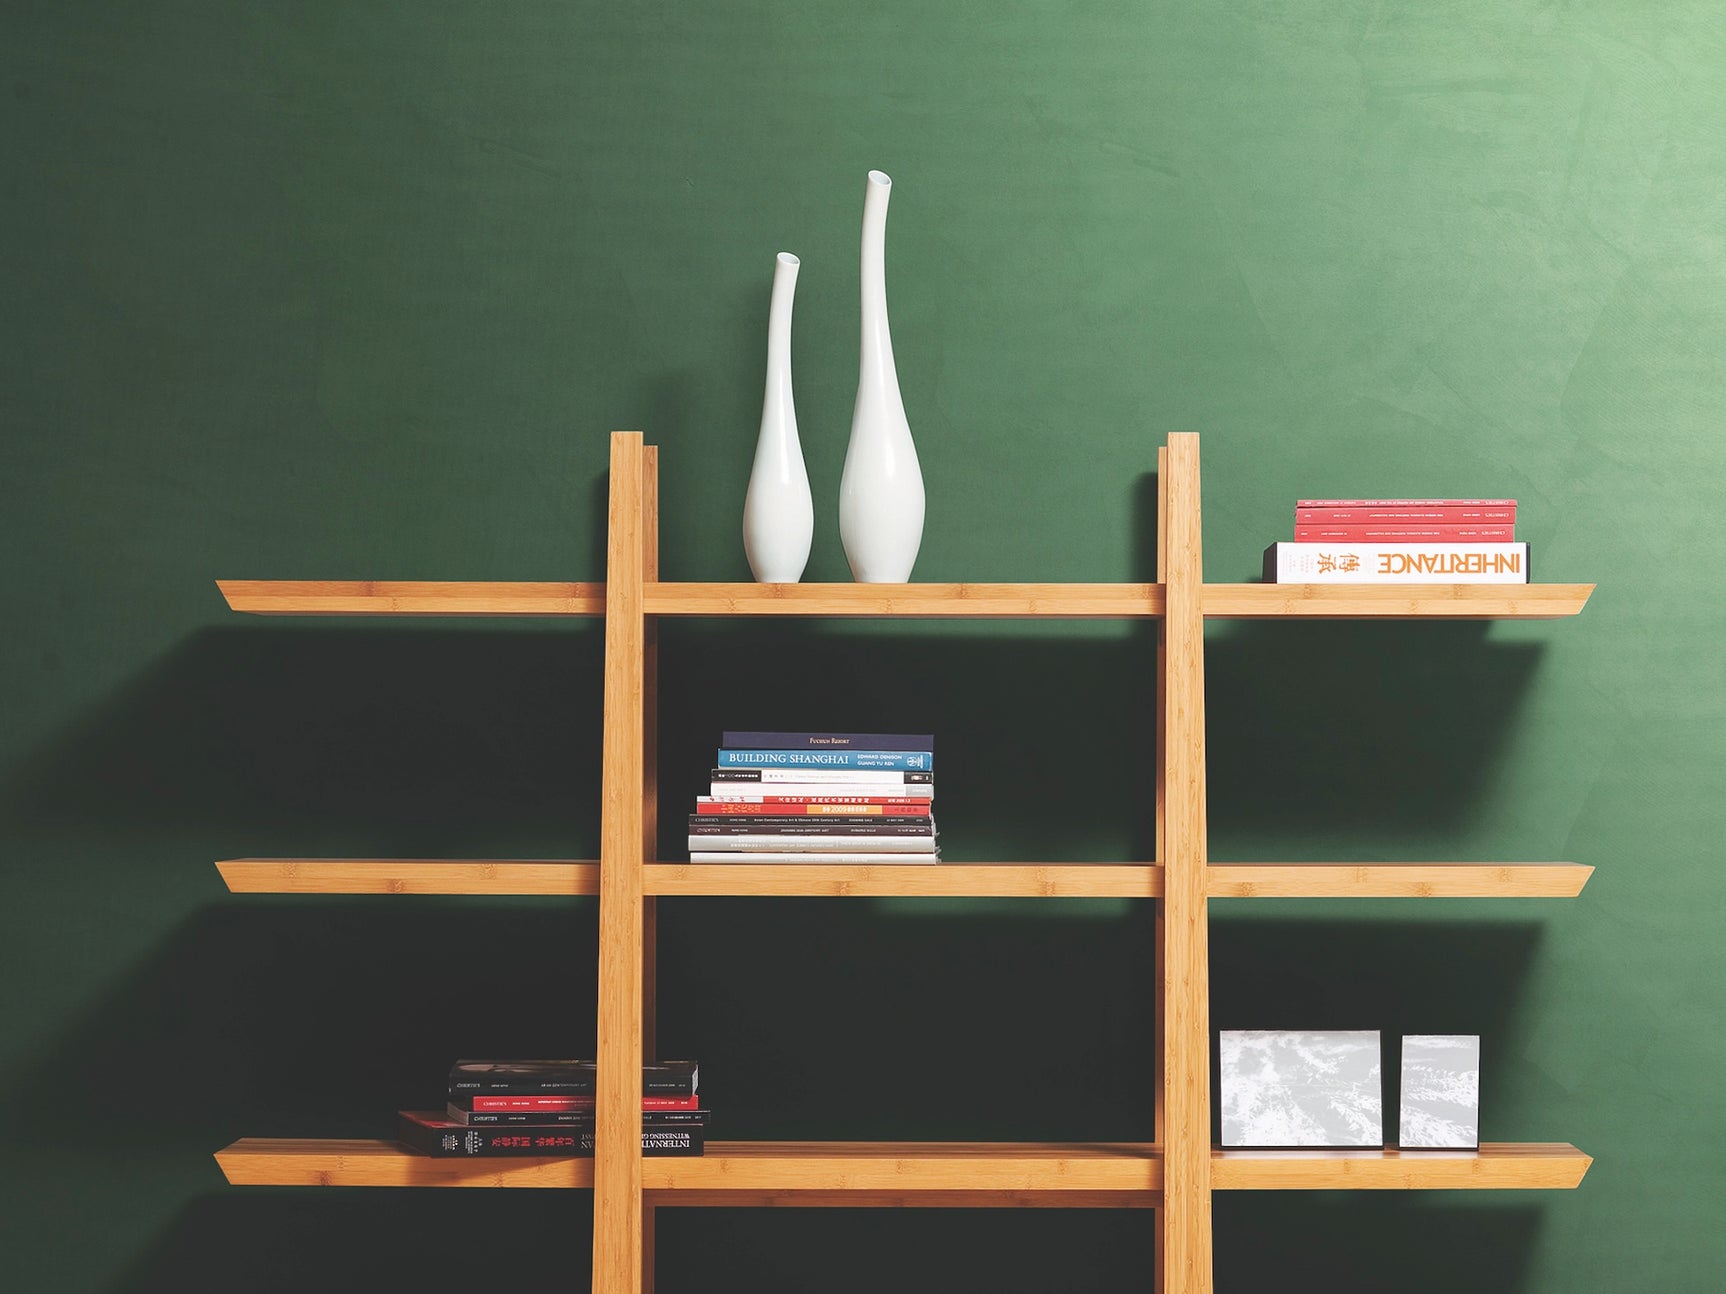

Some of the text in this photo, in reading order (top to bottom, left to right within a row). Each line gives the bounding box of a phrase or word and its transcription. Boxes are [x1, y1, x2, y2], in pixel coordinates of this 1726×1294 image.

[1316, 553, 1361, 575] 傳承
[1377, 553, 1521, 574] INHERITANCE
[729, 753, 849, 765] BUILDING SHANGHAI
